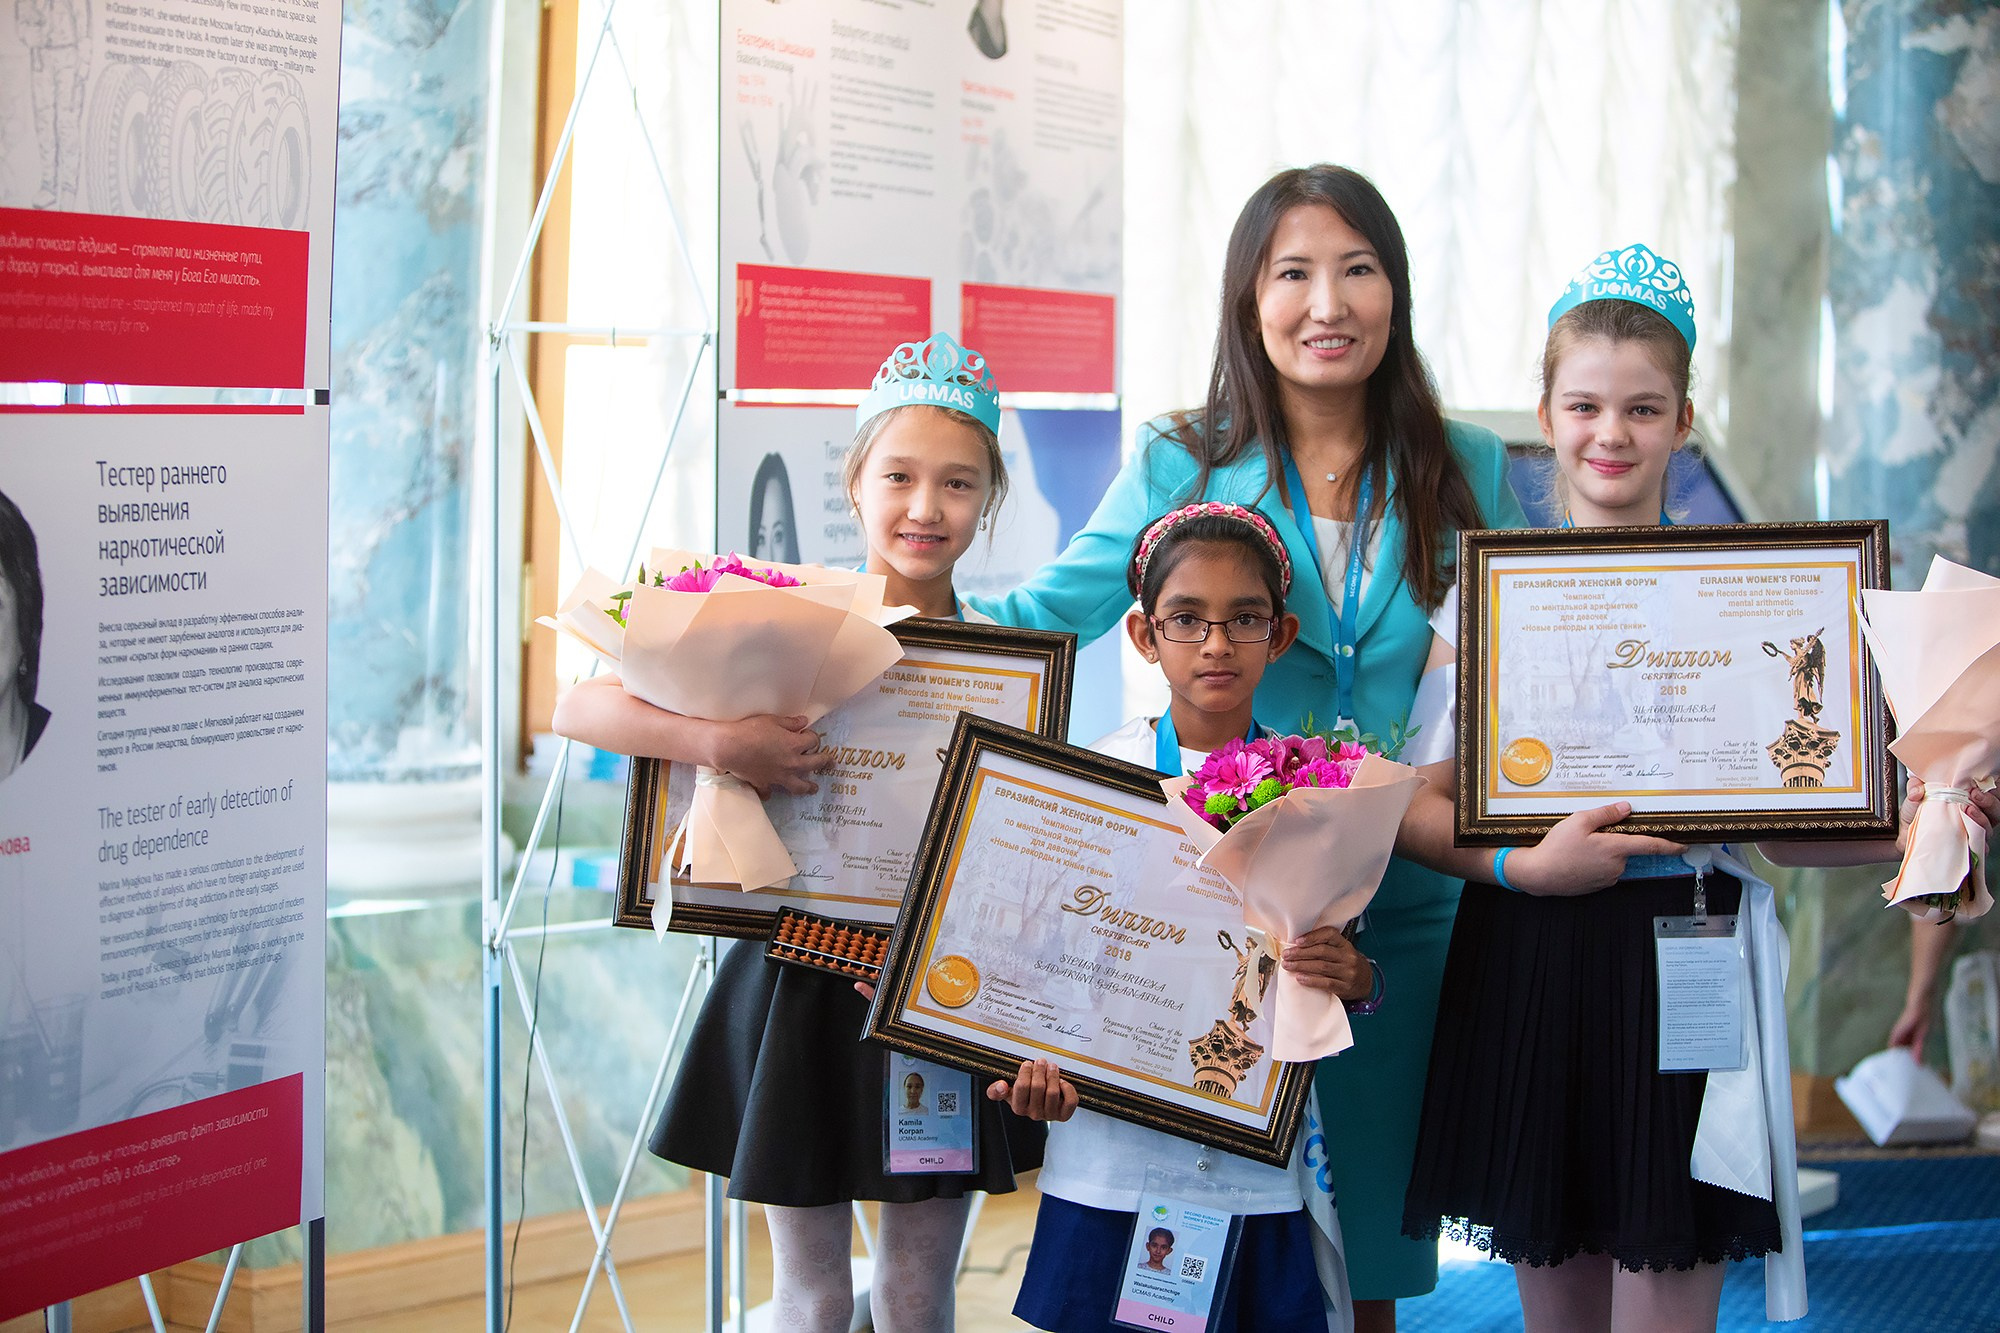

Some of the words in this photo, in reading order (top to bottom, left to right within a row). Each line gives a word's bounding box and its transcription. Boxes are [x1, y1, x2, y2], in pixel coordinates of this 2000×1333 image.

[285, 31, 307, 42] because
[308, 34, 317, 44] she
[181, 267, 201, 282] Бога
[203, 268, 217, 283] Его
[96, 461, 155, 492] Тестер
[161, 465, 227, 492] раннего
[98, 502, 190, 523] выявления
[99, 529, 225, 566] наркотической
[99, 571, 207, 597] зависимости
[1513, 578, 1575, 588] ЕВРАЗИЙСКИЙ
[1579, 577, 1621, 587] ЖЕНСКИЙ
[1625, 578, 1656, 586] ФОРУМ
[1700, 576, 1742, 584] EURASIAN
[1746, 575, 1786, 583] WOMEN'S
[1790, 574, 1820, 582] FORUM
[1590, 603, 1637, 611] арифметике
[1756, 598, 1793, 606] arithmetic
[1719, 609, 1771, 617] championship
[1786, 608, 1803, 616] girls
[1607, 640, 1731, 668] Диплом
[883, 671, 925, 682] EURASIAN
[929, 675, 969, 687] WOMEN'S
[973, 680, 1003, 690] FORUM
[879, 685, 895, 693] New
[897, 686, 928, 697] Records
[930, 691, 944, 699] and
[946, 692, 962, 700] New
[965, 693, 998, 704] Geniuses
[1660, 685, 1686, 695] 2018
[908, 700, 933, 708] mental
[897, 709, 949, 722] championship
[1633, 715, 1661, 725] Мария
[830, 782, 856, 795] 2018
[98, 807, 123, 830] The
[127, 804, 165, 826] tester
[169, 796, 183, 818] of
[186, 792, 217, 819] early
[221, 786, 277, 811] detection
[281, 778, 293, 801] of
[995, 787, 1057, 812] ЕВРАЗИЙСКИЙ
[1059, 806, 1103, 826] ЖЕНСКИЙ
[1105, 821, 1137, 836] ФОРУМ
[1041, 815, 1082, 834] Чемпионат
[1004, 818, 1013, 826] по
[1016, 822, 1061, 840] ментальной
[1063, 836, 1110, 855] арифметике
[98, 840, 128, 865] drug
[132, 828, 209, 860] dependence
[1030, 838, 1045, 847] для
[1046, 843, 1078, 857] девочек
[253, 854, 262, 863] the
[1020, 847, 1054, 861] рекорды
[1062, 860, 1084, 870] юные
[1172, 856, 1189, 866] New
[271, 865, 281, 875] and
[292, 861, 304, 871] used
[1199, 877, 1225, 889] mental
[1186, 885, 1239, 906] championship
[1061, 885, 1185, 943] Диплом
[1104, 945, 1131, 961] 2018
[1152, 1292, 1175, 1303] Academy
[1148, 1313, 1175, 1326] CHILD
